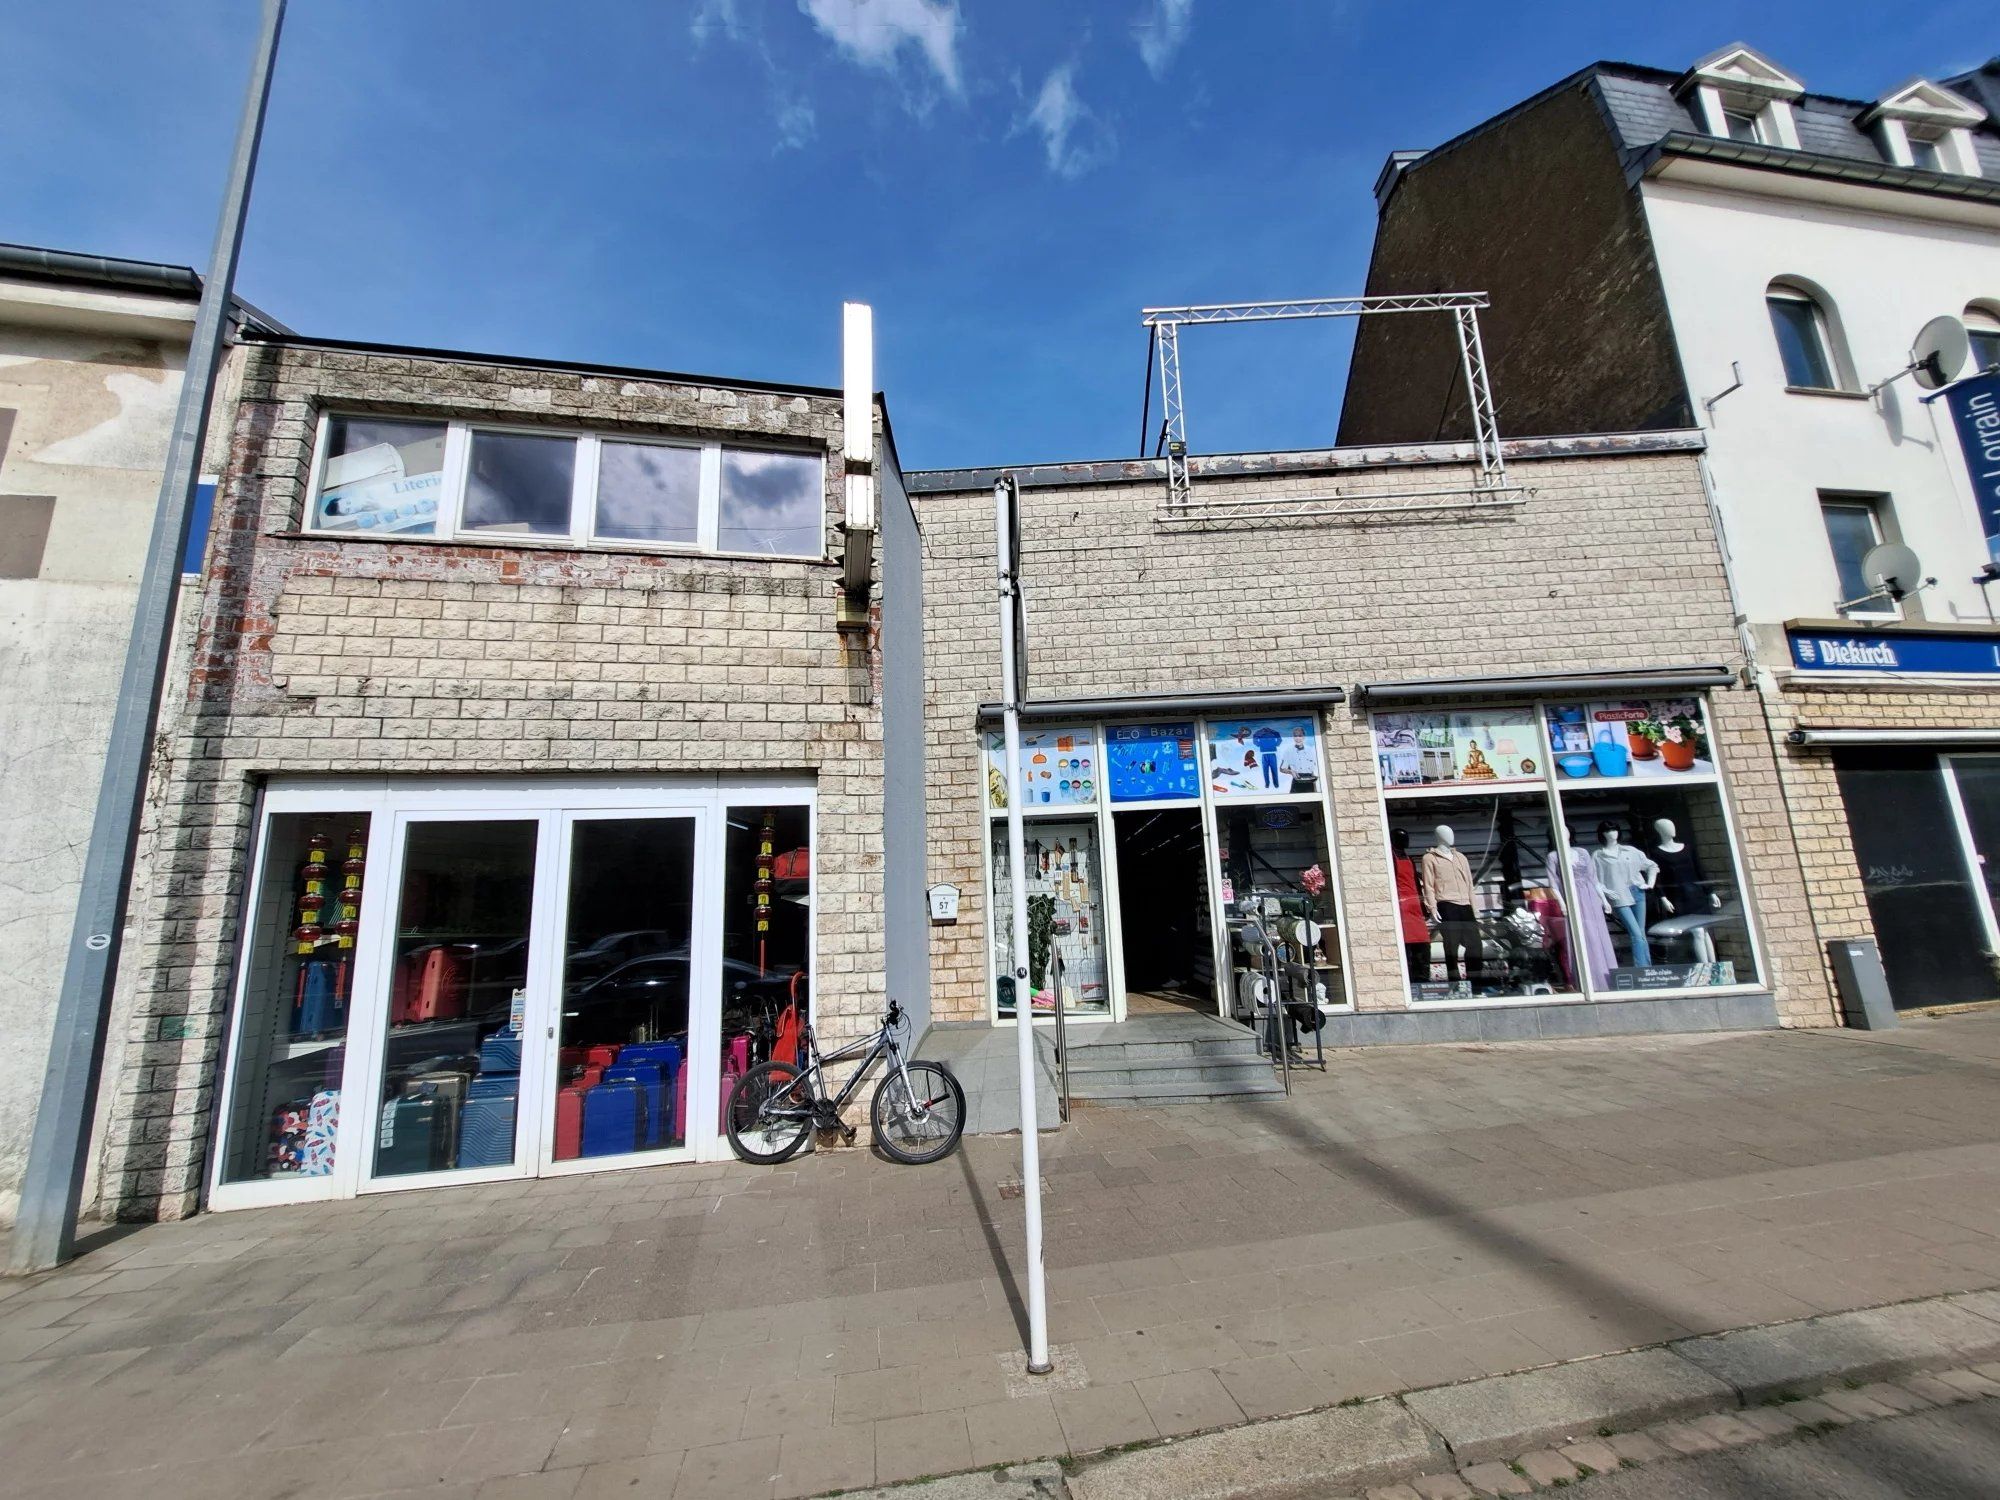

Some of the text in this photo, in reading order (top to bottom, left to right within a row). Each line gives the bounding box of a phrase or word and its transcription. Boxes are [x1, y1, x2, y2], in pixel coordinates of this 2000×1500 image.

[1819, 639, 1898, 666] Diekirch
[1599, 711, 1645, 720] PlasticForte
[1150, 727, 1188, 737] Bazar
[939, 901, 949, 910] 57
